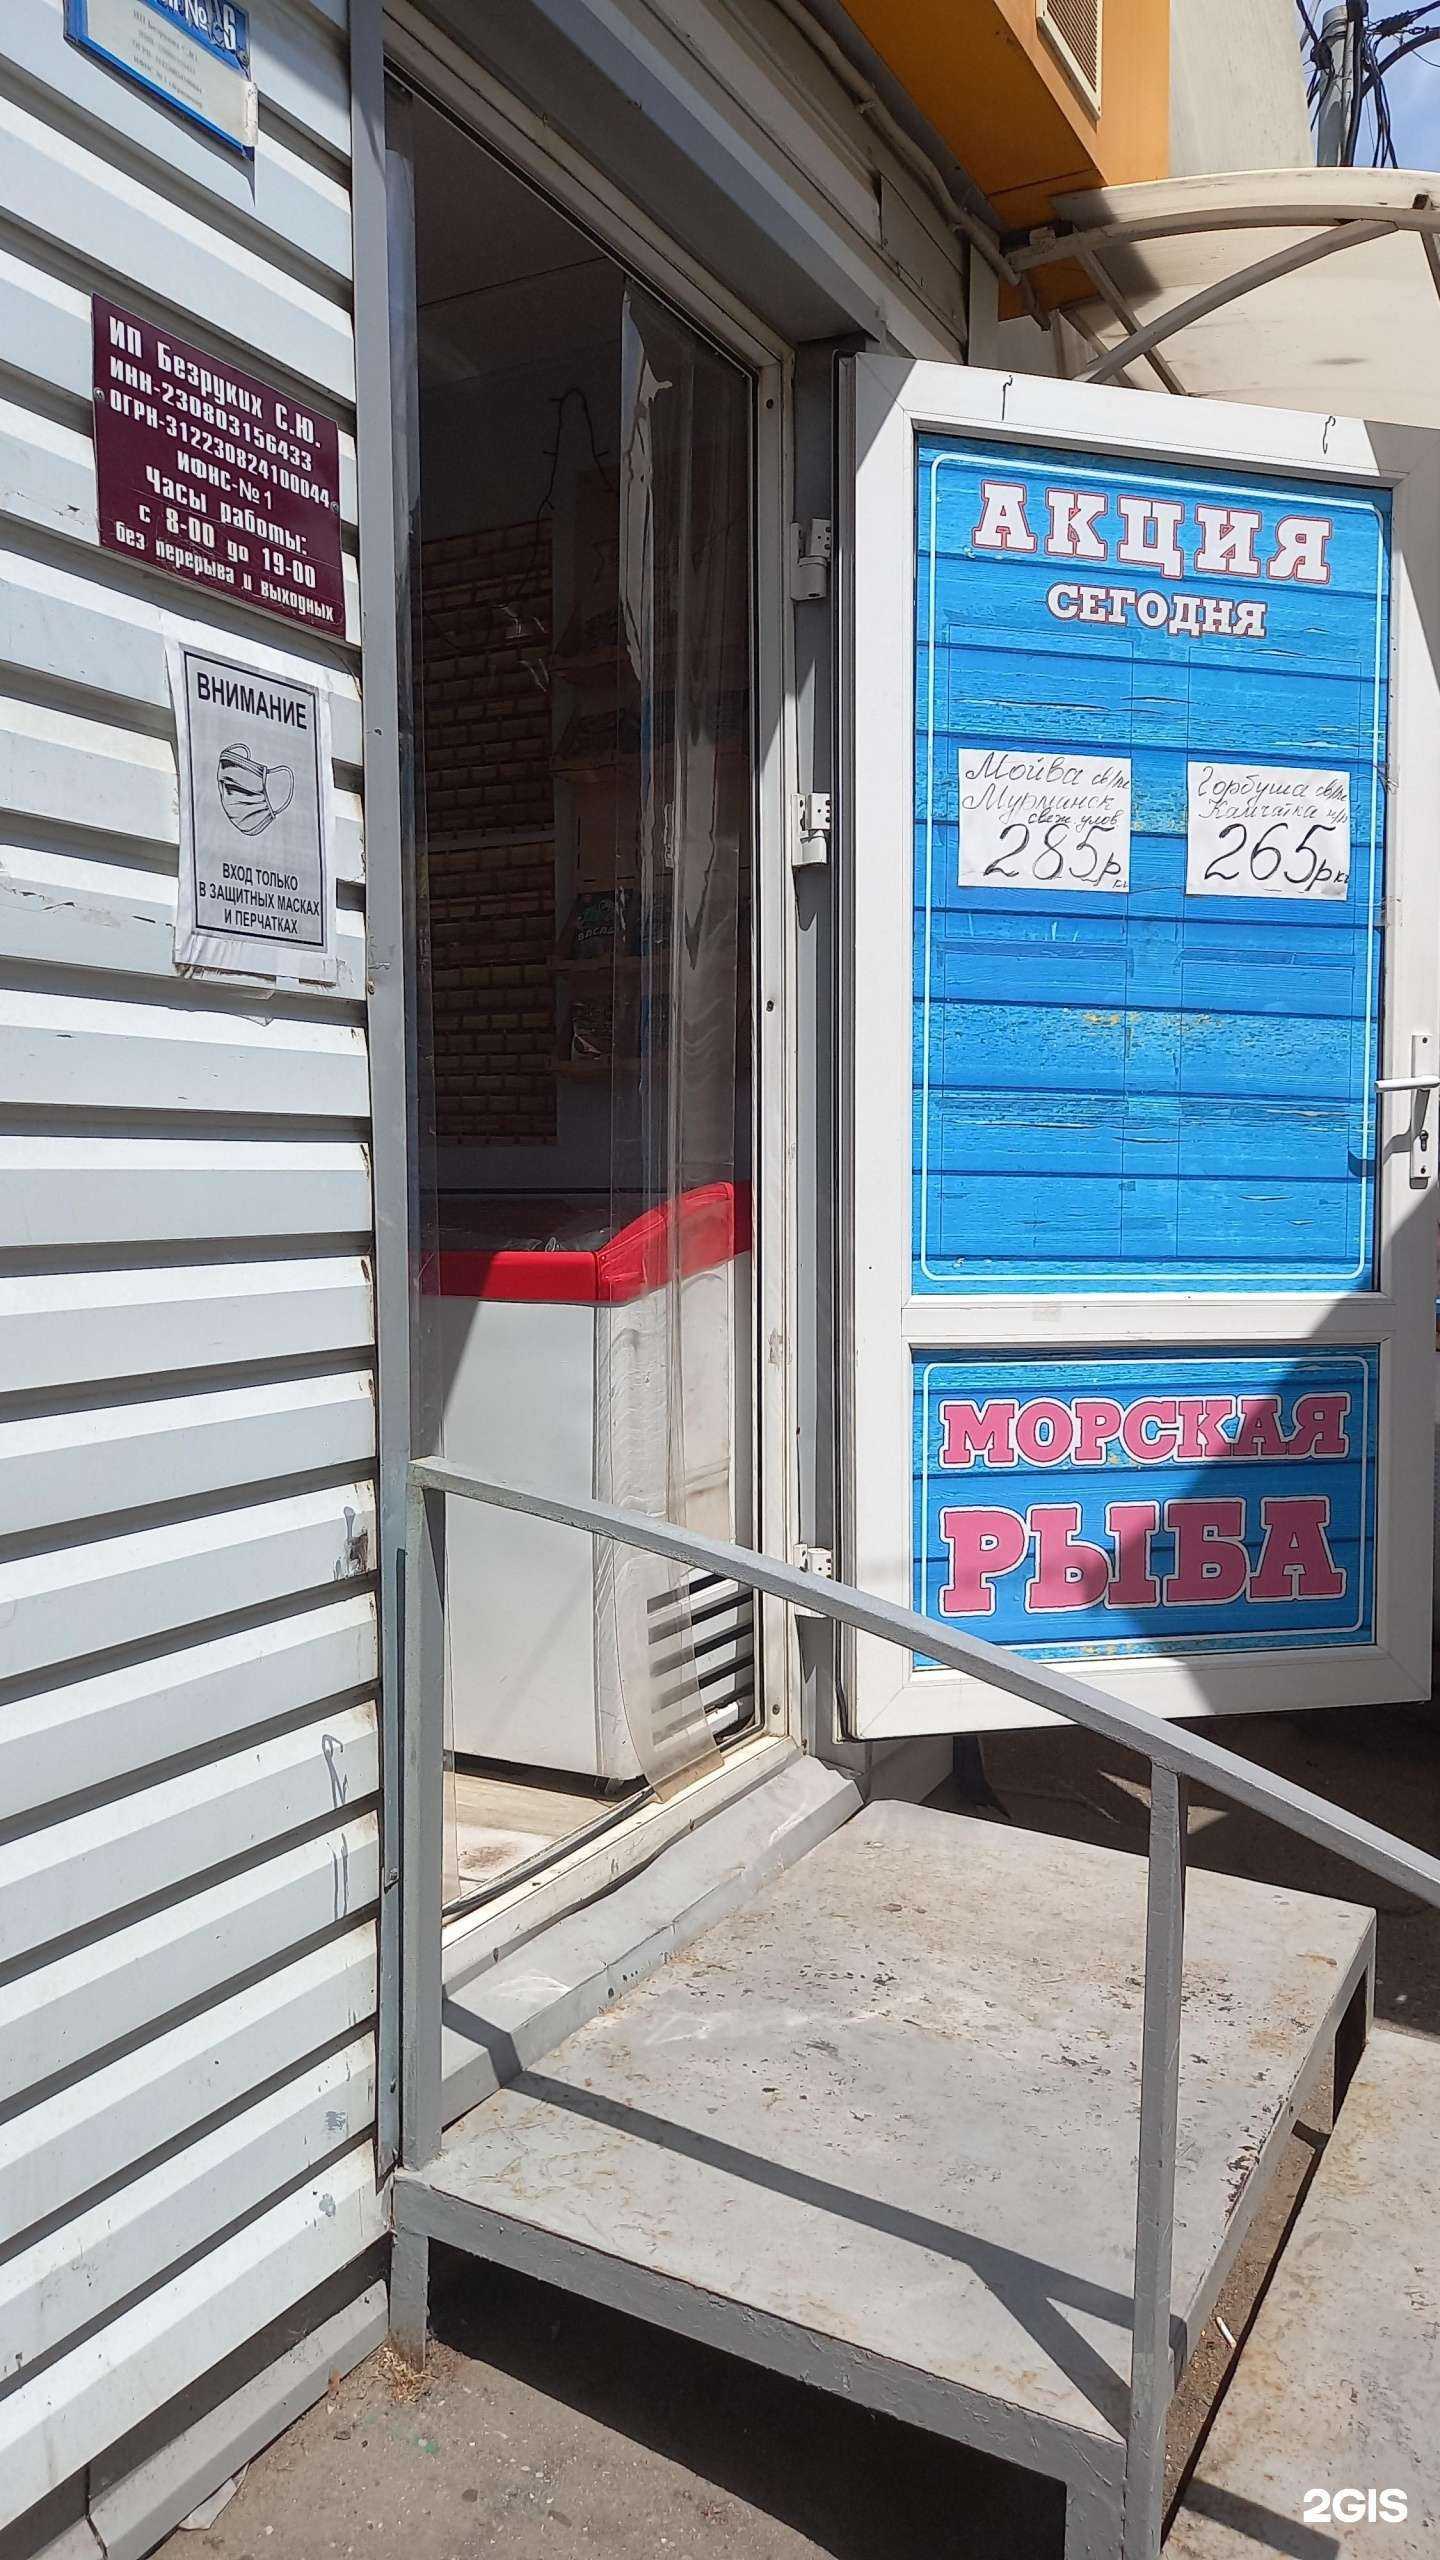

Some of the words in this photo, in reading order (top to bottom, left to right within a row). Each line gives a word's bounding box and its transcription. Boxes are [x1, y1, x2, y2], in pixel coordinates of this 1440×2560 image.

[109, 316, 142, 358] ИП
[157, 341, 263, 419] Безруких
[275, 403, 321, 448] С.Ю.
[110, 356, 313, 472] ИНН-230803156433
[139, 505, 151, 523] с
[166, 507, 215, 549] 8-00
[227, 539, 249, 563] до
[262, 547, 316, 589] 19-00
[146, 465, 207, 513] Часы
[220, 501, 308, 556] работы:
[972, 479, 1333, 585] АКЦИЯ
[115, 521, 145, 551] без
[156, 539, 234, 586] перерыва
[243, 572, 252, 591] и
[261, 580, 334, 622] выходных
[1046, 582, 1268, 639] СЕГОДНЯ
[197, 672, 307, 730] ВНИМАНИЕ
[965, 752, 1083, 785] Мойва
[199, 881, 206, 898] В
[210, 886, 275, 909] ЗАЩИТНЫХ
[277, 899, 320, 916] МАСКАХ
[222, 862, 253, 886] ВХОД
[256, 869, 298, 891] ТОЛЬКО
[224, 907, 232, 925] И
[235, 909, 298, 934] ПЕРЧАТКАХ
[938, 1391, 1352, 1469] МОРСКАЯ
[938, 1497, 1347, 1618] РЫБА
